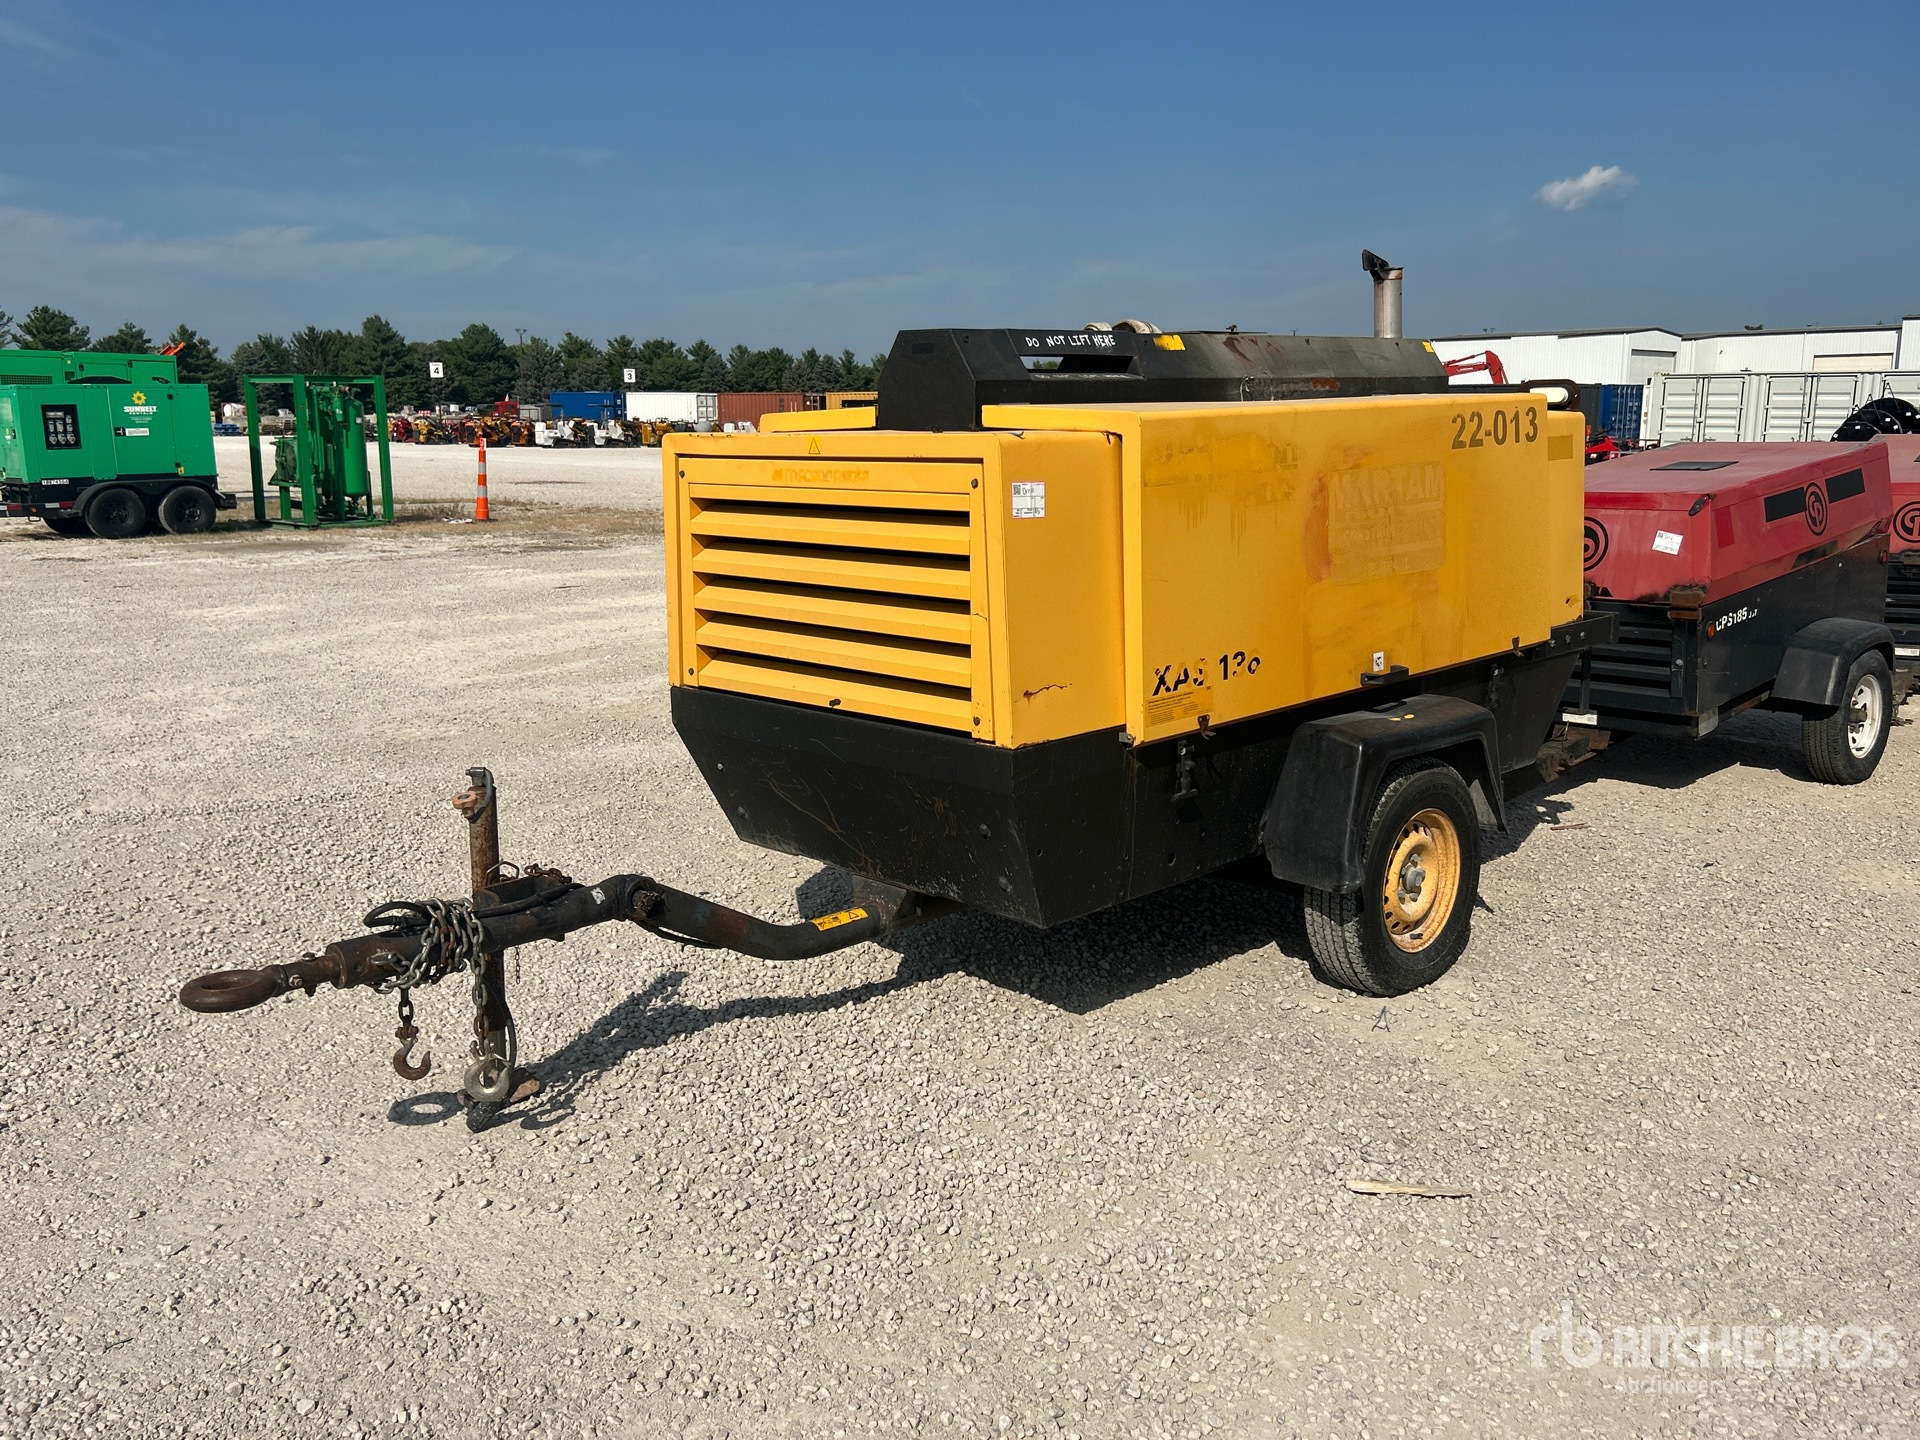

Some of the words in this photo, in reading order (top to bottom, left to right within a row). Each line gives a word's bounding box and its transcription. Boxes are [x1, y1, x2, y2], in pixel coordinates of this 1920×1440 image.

[1025, 336, 1040, 347] DO
[1045, 335, 1066, 347] NOT
[1068, 335, 1091, 346] LIFT
[1092, 334, 1116, 347] HERE
[627, 372, 633, 380] 3
[1451, 406, 1538, 450] 22-013
